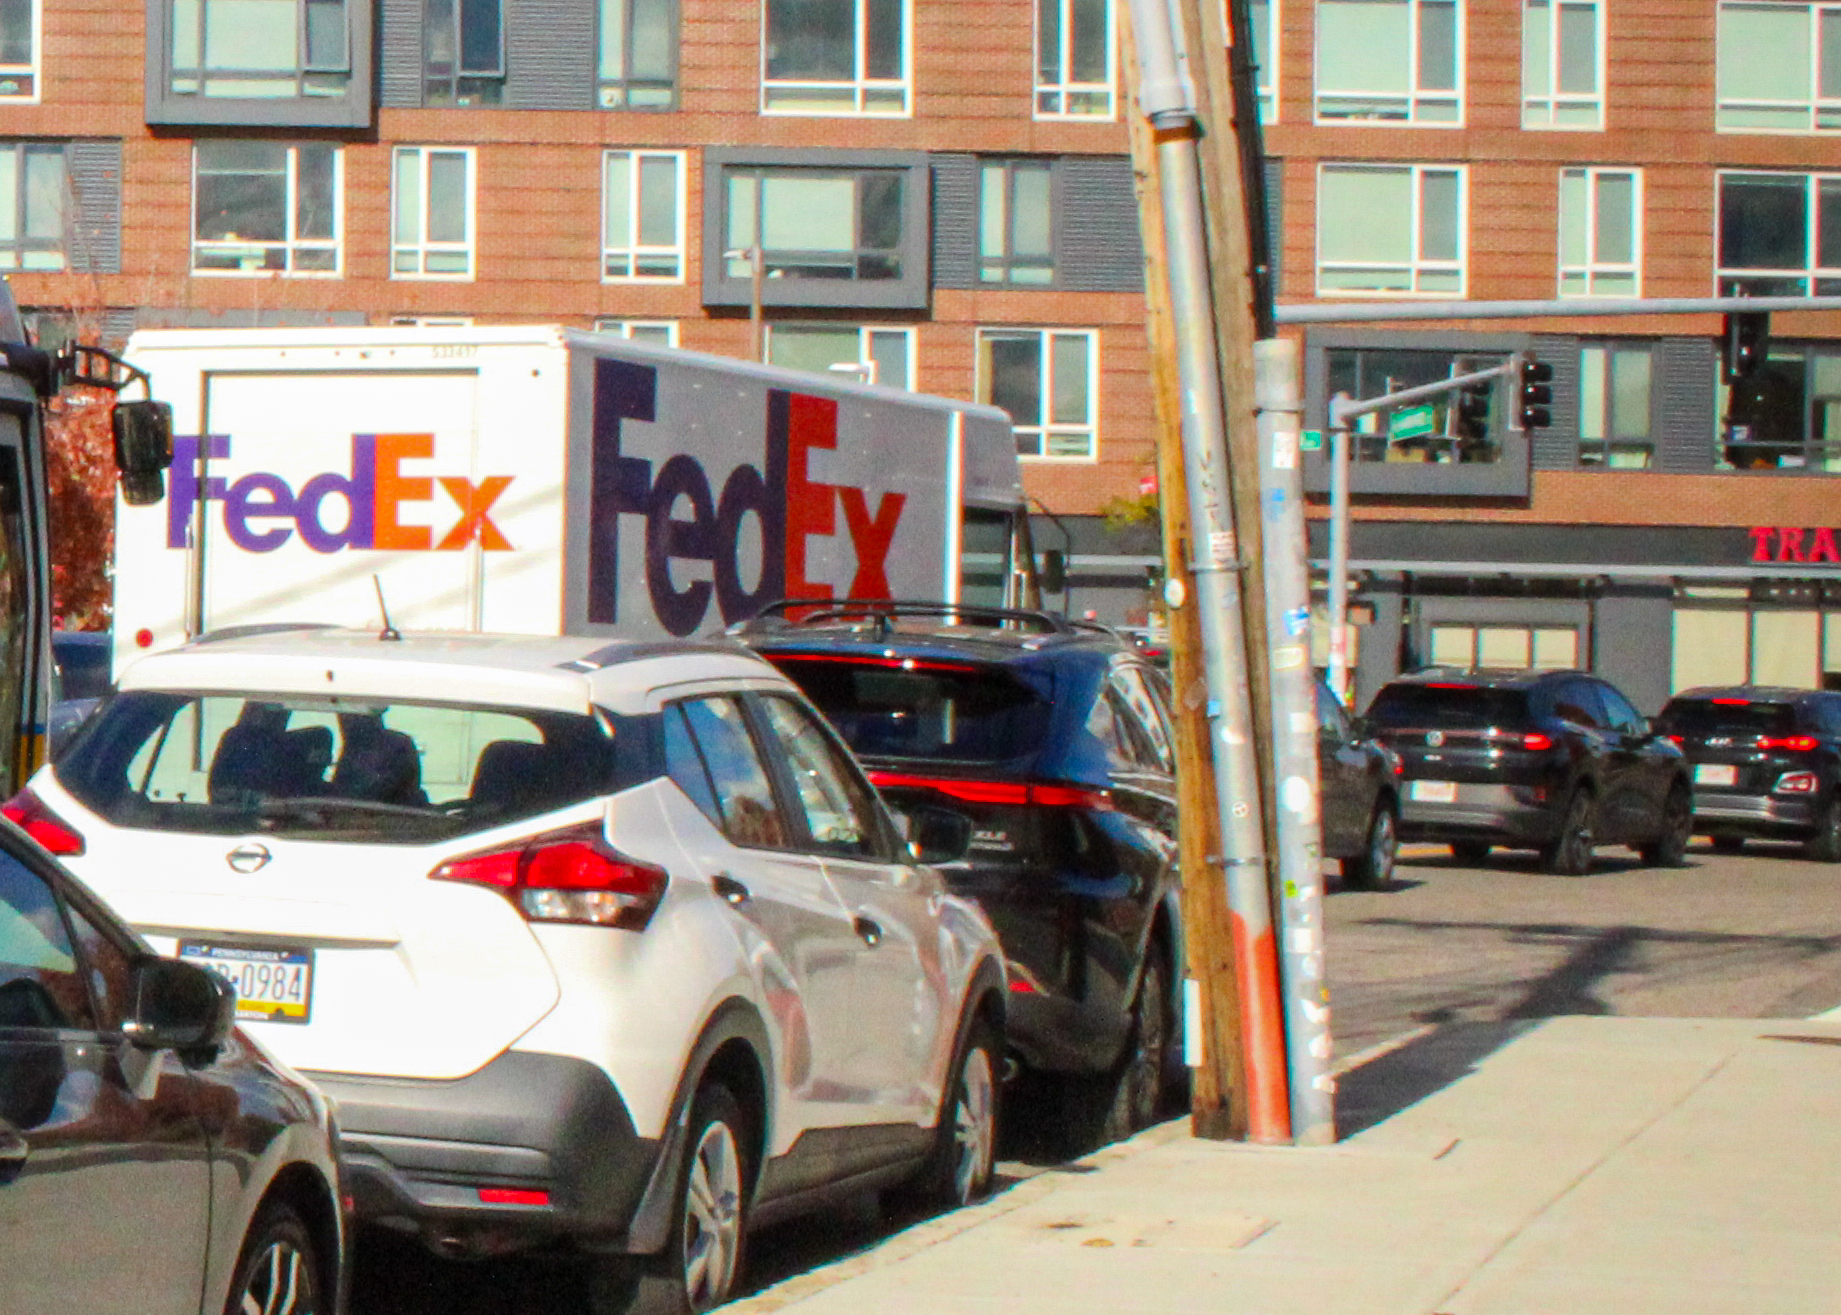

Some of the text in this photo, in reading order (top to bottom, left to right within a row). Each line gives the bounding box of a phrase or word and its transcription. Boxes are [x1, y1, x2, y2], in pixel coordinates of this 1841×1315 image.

[167, 432, 517, 554] FedEx
[587, 358, 906, 637] FedEx
[1748, 526, 1841, 562] TRA
